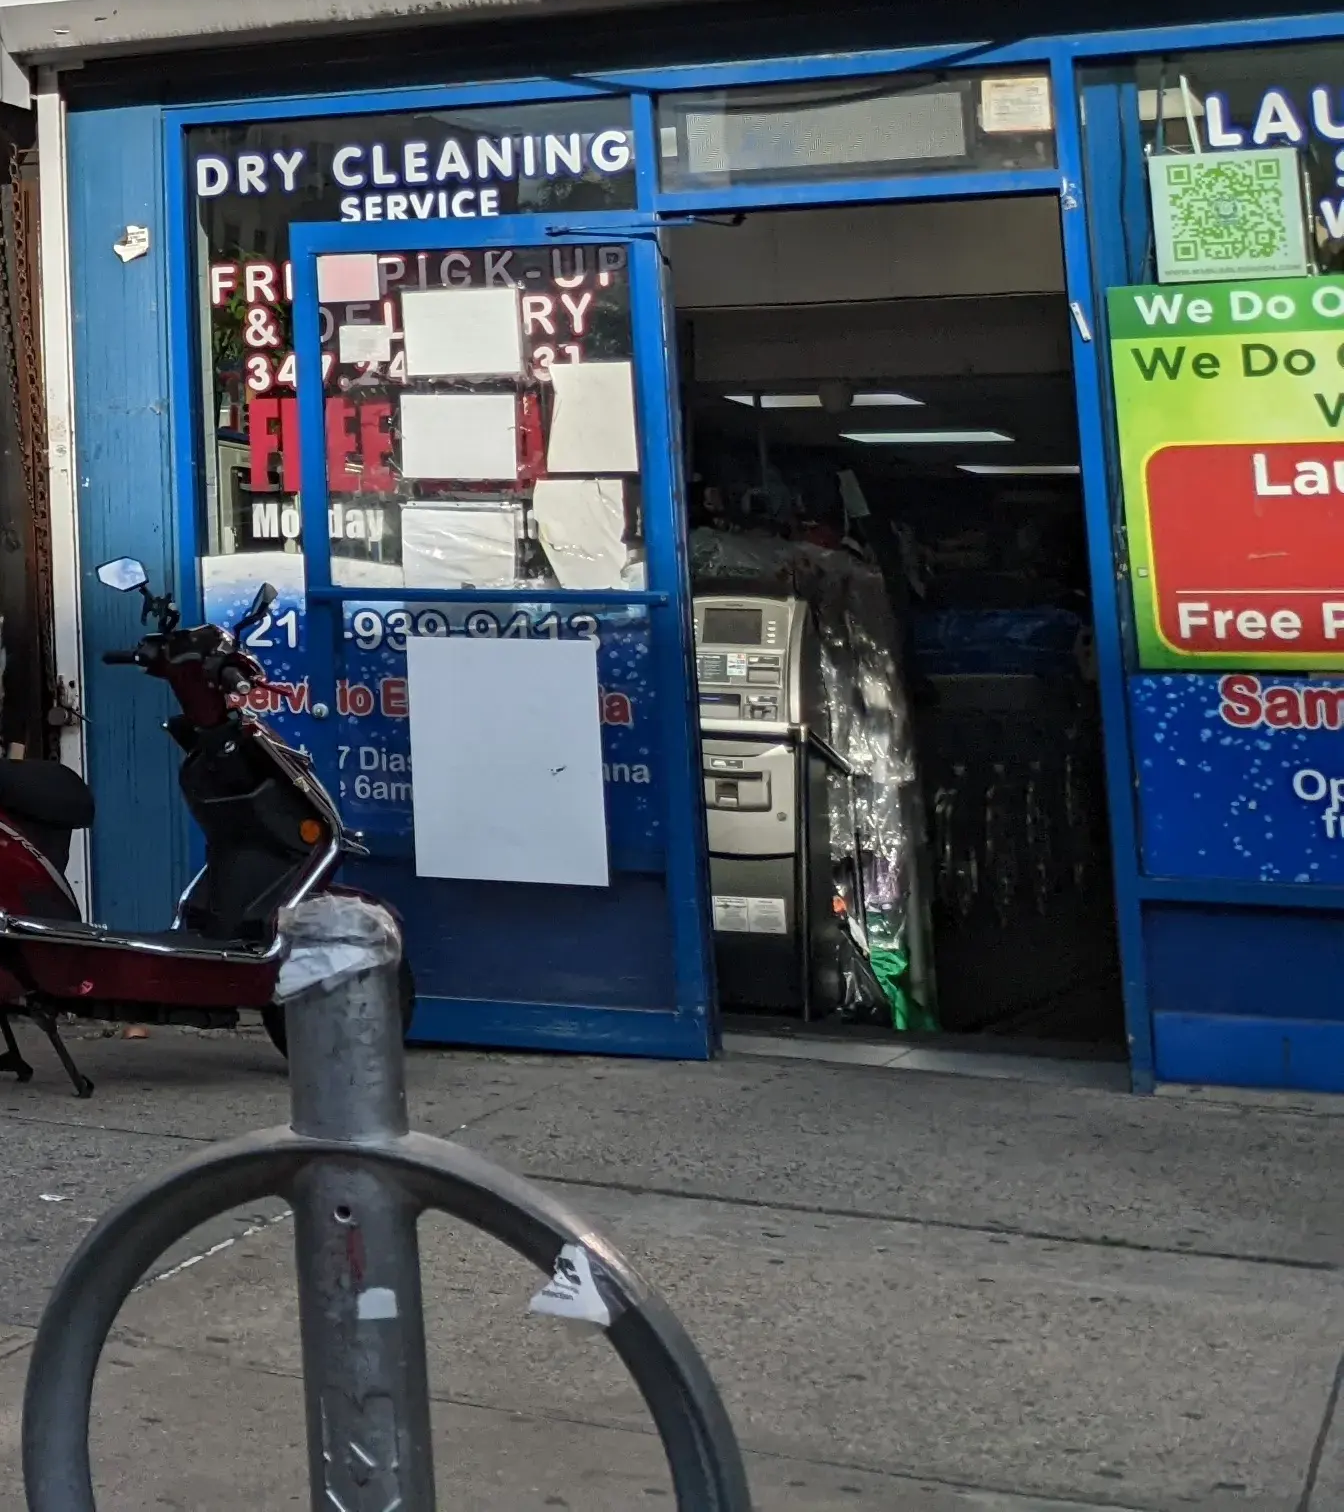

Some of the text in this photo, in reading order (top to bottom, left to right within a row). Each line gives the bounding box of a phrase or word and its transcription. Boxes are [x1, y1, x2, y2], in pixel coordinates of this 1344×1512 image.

[196, 130, 630, 198] DRY CLEANING
[340, 189, 499, 222] SERVICE
[245, 306, 280, 348] &
[1134, 295, 1214, 326] We
[1230, 290, 1295, 322] Do
[1131, 345, 1221, 381] We
[1241, 342, 1316, 378] Do
[252, 502, 384, 542] Moday
[1177, 601, 1301, 641] Free
